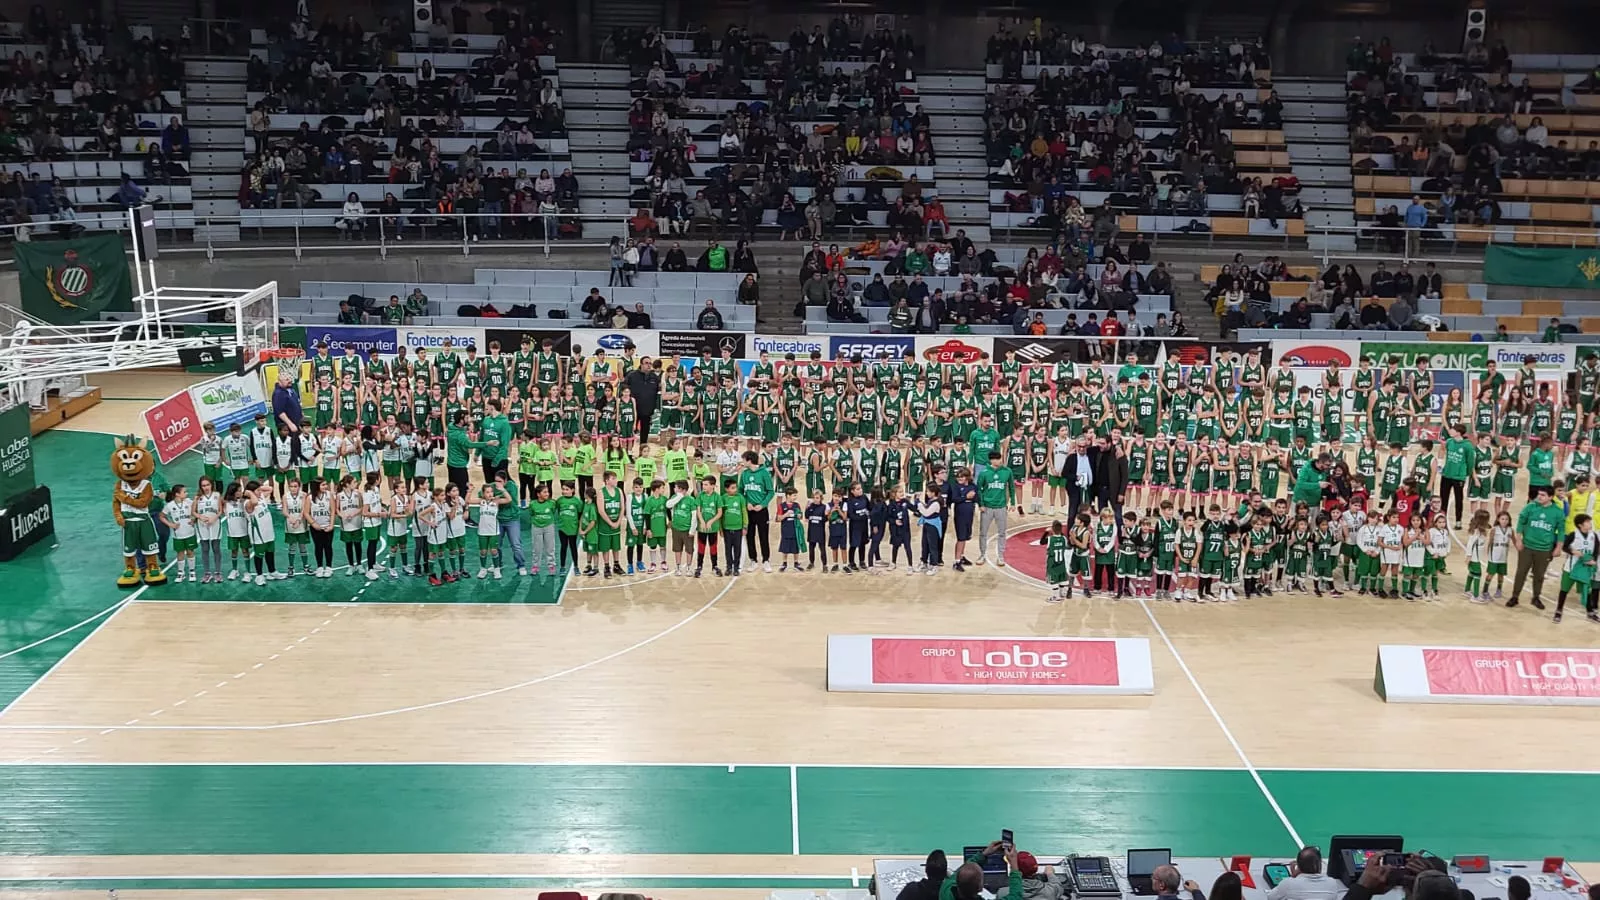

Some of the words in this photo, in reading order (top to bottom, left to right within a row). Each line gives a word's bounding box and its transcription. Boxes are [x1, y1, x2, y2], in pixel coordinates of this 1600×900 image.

[330, 339, 395, 351] ecmputer
[406, 332, 476, 347] Fontecbras
[754, 338, 821, 351] Fontecabras
[160, 416, 190, 442] Lobe
[0, 436, 29, 458] Lobe
[10, 503, 50, 542] Huesca
[1530, 520, 1552, 531] PEÑAS
[922, 648, 956, 656] GRUPO
[962, 644, 1068, 668] Lobe
[1474, 660, 1509, 668] GRUPO
[1516, 656, 1600, 680] Lob
